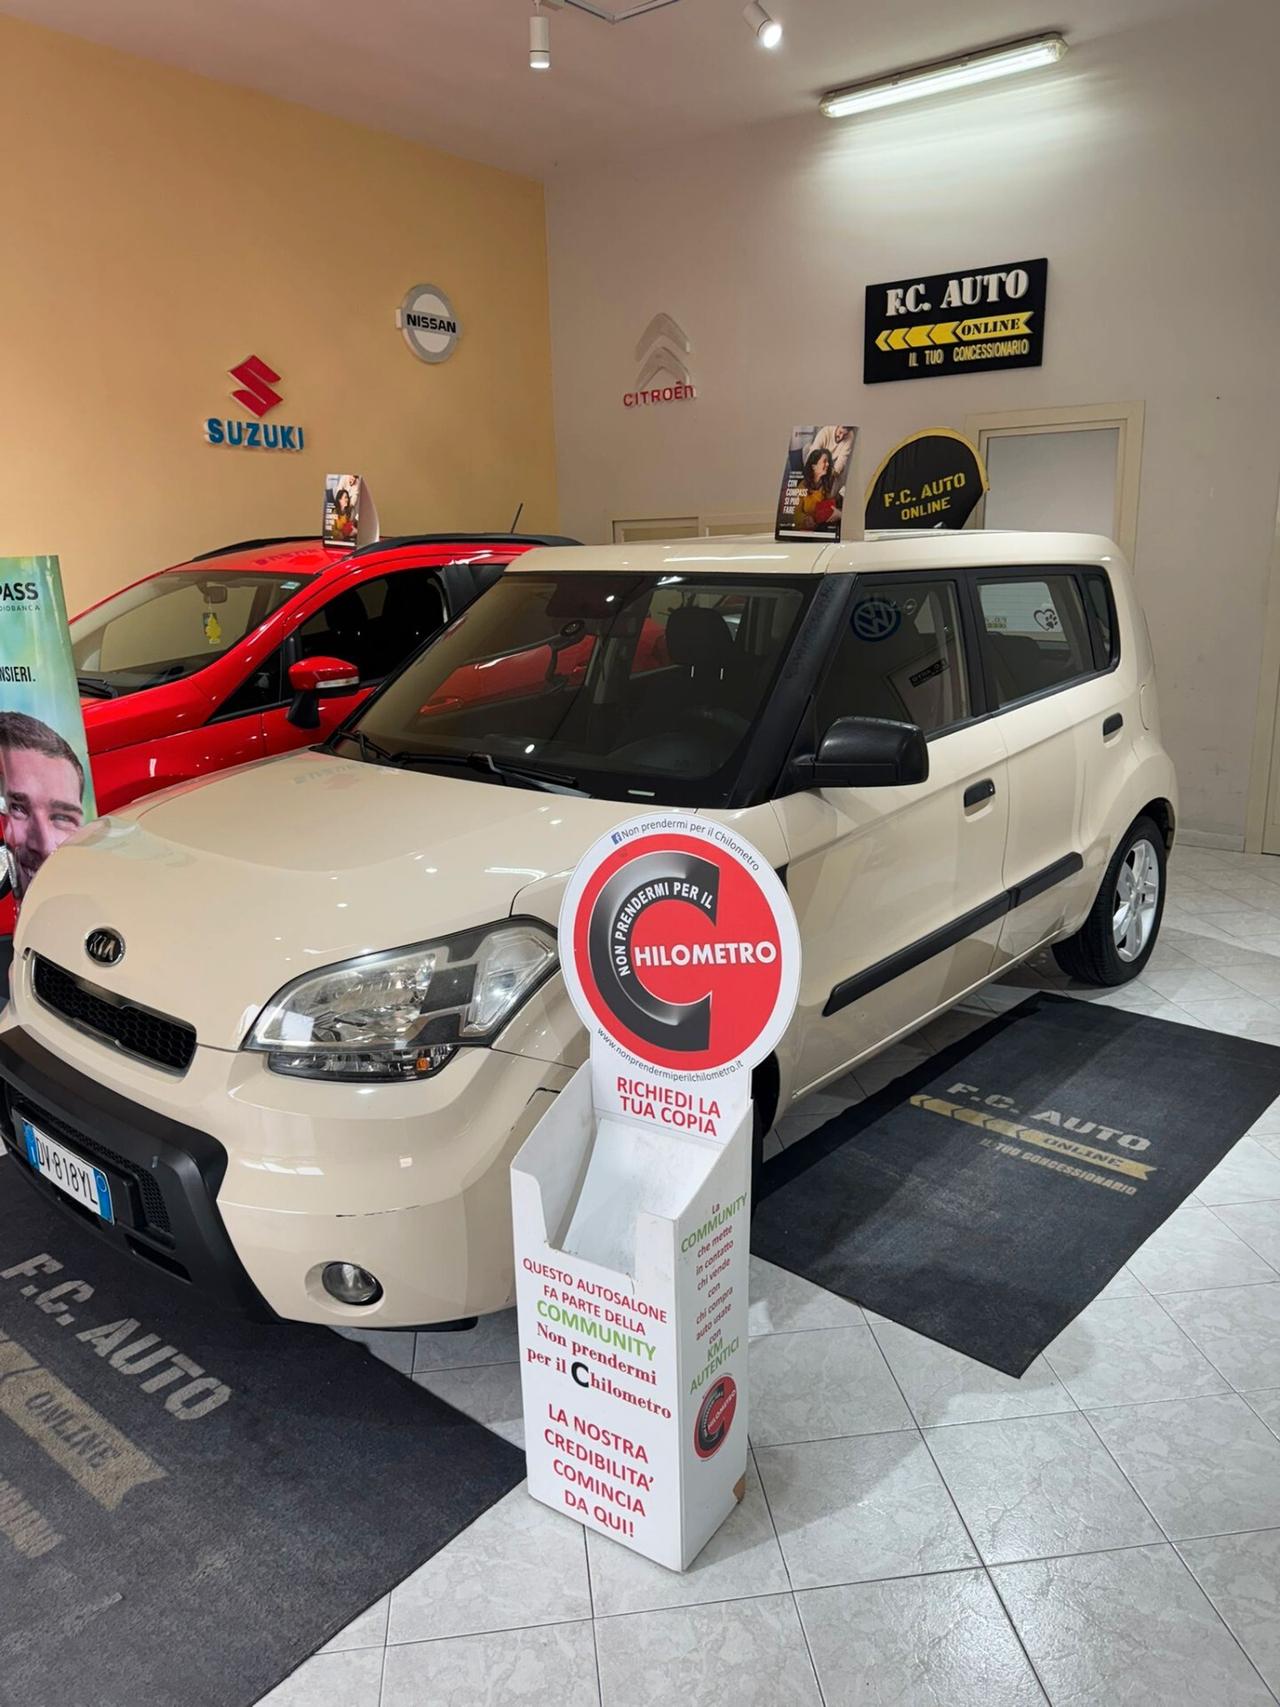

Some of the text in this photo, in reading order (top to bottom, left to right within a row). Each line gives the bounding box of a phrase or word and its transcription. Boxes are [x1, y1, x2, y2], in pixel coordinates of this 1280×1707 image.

[886, 269, 1029, 316] F.C. AUTO
[407, 313, 456, 333] NISSAN
[961, 318, 1020, 336] ONLINE
[908, 339, 1029, 367] IL TUO CONCESSIONARIO
[205, 418, 304, 450] SUZUKI
[884, 472, 966, 507] F.C. AUTO
[901, 496, 951, 520] ONLINE
[0, 582, 39, 601] ASS
[621, 819, 759, 871] Non prendermi per il Chilometro
[90, 935, 116, 961] KIA
[614, 881, 713, 977] NON PRENDERMI PER IL
[597, 1028, 744, 1083] www.nonprendermiperilchilometro.it
[617, 1076, 721, 1118] RICHIEDI LA
[620, 1095, 717, 1137] TUA COPIA
[946, 1082, 1152, 1151] F.C. AUTO
[996, 1142, 1019, 1157] TUO
[1021, 1151, 1138, 1196] CONCESSIONARIO
[1043, 1137, 1124, 1168] ONLINE
[681, 1192, 747, 1253] COMMUNITY
[712, 1203, 720, 1214] La
[696, 1240, 734, 1275] in contatto
[697, 1225, 733, 1258] che mette
[523, 1257, 667, 1324] QUESTO AUTOSALONE
[697, 1258, 731, 1291] chi vende
[708, 1282, 721, 1298] con
[544, 1285, 646, 1336] FA PARTE DELLA
[696, 1286, 734, 1325] chi compra
[696, 1303, 732, 1341] auto usate
[0, 1252, 232, 1420] F.C. AUTO
[536, 1300, 657, 1361] COMMUNITY
[707, 1337, 723, 1362] KM
[708, 1328, 722, 1345] con
[537, 1321, 657, 1386] Non prendermi
[690, 1336, 740, 1395] AUTENTICI
[527, 1348, 672, 1419] per il Chilometro
[25, 1391, 122, 1469] ONLINE
[548, 1403, 648, 1464] LA NOSTRA
[553, 1459, 646, 1517] COMINCIA
[564, 1490, 634, 1538] DA QUI!
